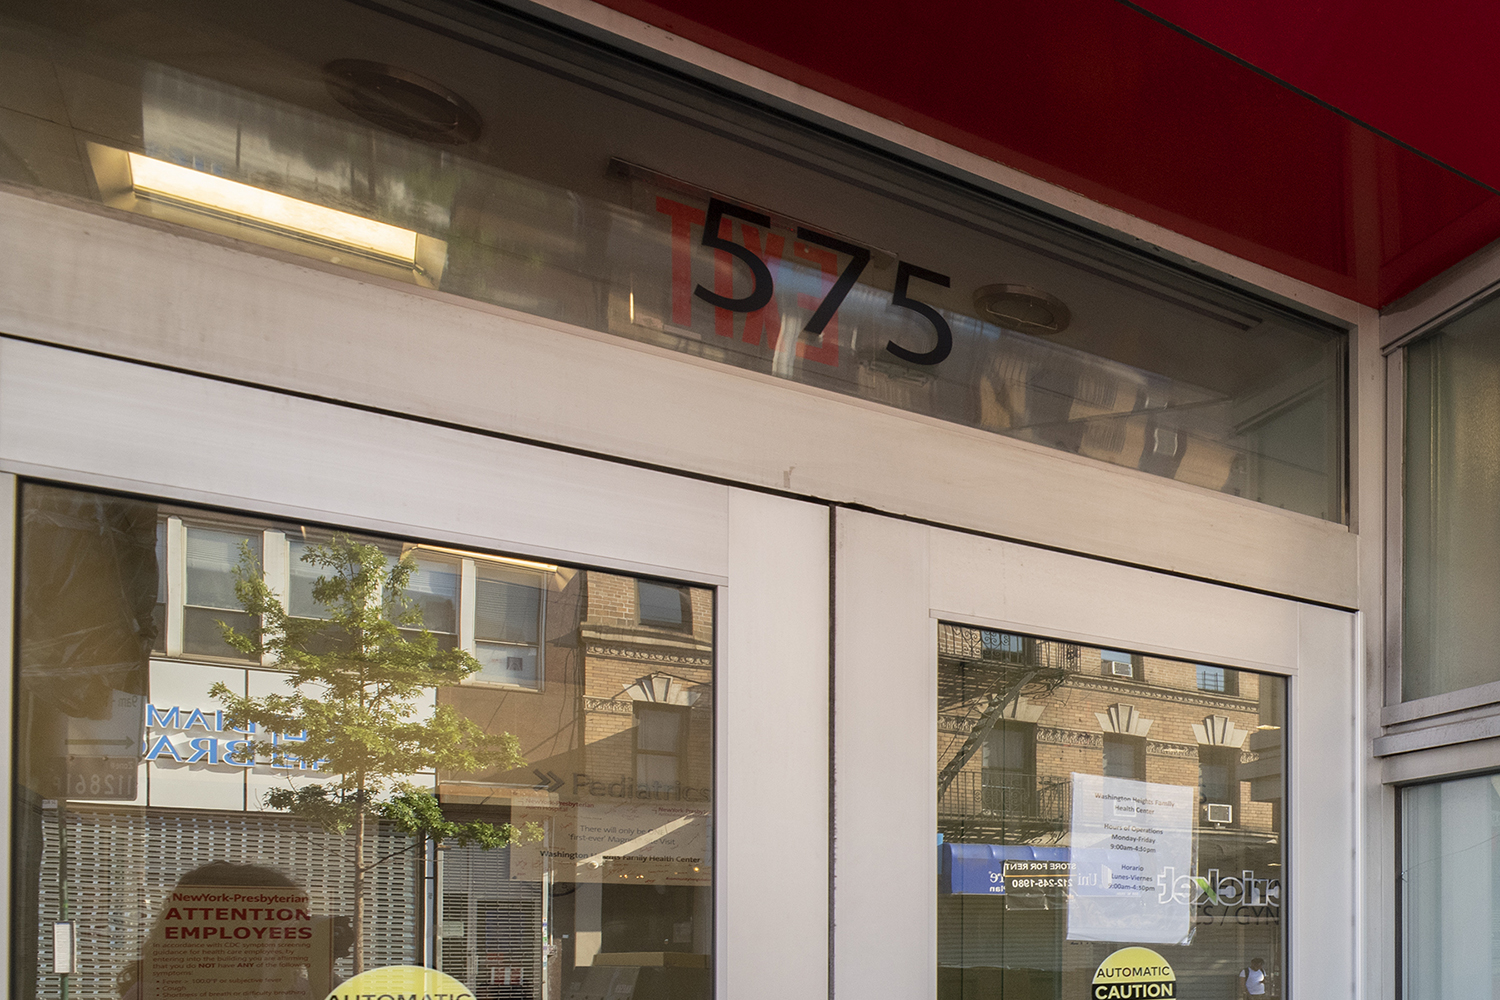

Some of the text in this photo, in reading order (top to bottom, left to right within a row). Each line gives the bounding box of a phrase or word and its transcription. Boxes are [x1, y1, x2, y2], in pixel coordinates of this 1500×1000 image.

[693, 197, 953, 366] 575
[573, 773, 710, 801] Pediatrics
[1094, 793, 1131, 802] Washington
[1154, 800, 1176, 808] Family
[580, 825, 604, 834] There
[606, 826, 618, 834] will
[620, 826, 636, 837] only
[637, 828, 646, 836] be
[1131, 826, 1164, 835] Operations
[1112, 834, 1156, 844] Monday-Friday
[540, 851, 588, 860] Washington
[623, 855, 648, 864] Family
[650, 855, 674, 863] Health
[676, 856, 701, 864] Center
[1122, 864, 1144, 872] Horario
[1112, 874, 1153, 882] Lunes-Viernes
[173, 893, 309, 905] NewYork-Presbyterian
[165, 908, 311, 921] ATTENTION
[165, 927, 313, 940] EMPLOYEES
[1096, 966, 1171, 979] AUTOMATIC
[1094, 984, 1174, 1000] CAUTION
